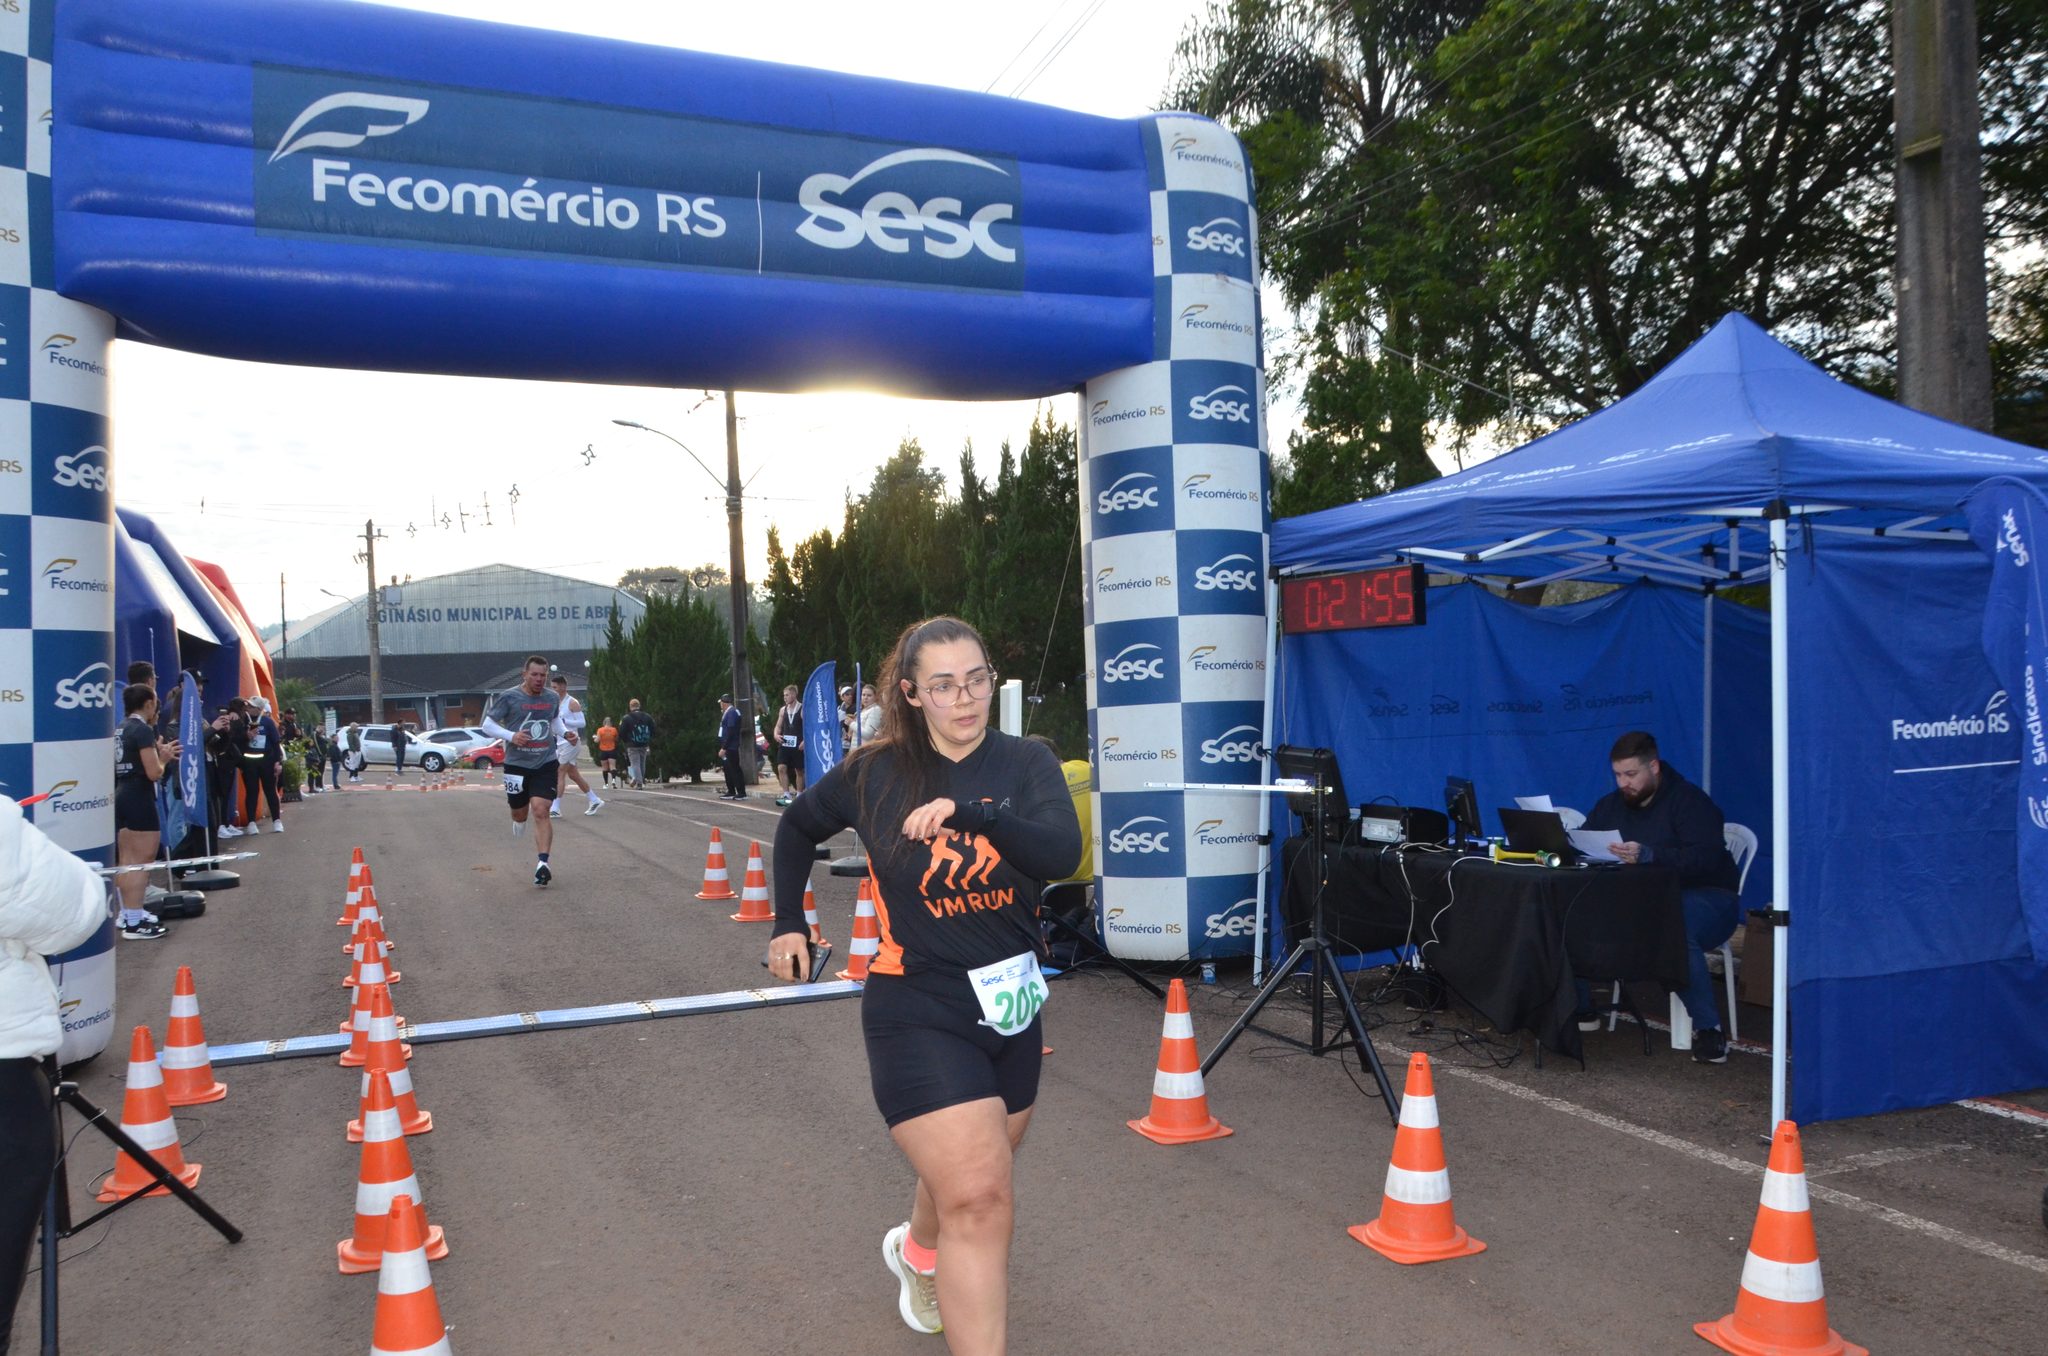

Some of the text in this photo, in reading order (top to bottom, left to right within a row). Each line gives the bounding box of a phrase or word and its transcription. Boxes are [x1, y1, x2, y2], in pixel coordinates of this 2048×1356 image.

[1177, 149, 1243, 174] Fecomércio RS
[312, 159, 727, 239] Fecomércio RS
[796, 148, 1017, 264] Sesc
[1186, 217, 1245, 258] Sesc
[1186, 317, 1254, 336] Fecomércio RS
[1093, 406, 1165, 427] Fecomércio RS
[1188, 385, 1250, 424] Sesc
[0, 460, 23, 473] RS
[1098, 472, 1158, 514] Sesc
[1189, 487, 1248, 501] Fecomércio
[1248, 491, 1259, 503] RS
[2001, 508, 2029, 568] Senac
[1098, 577, 1152, 594] Fecomércio
[1155, 575, 1171, 587] RS
[1194, 553, 1257, 592] Sesc
[376, 605, 627, 624] GINÁSIO MUNICIPAL 29 DE ABRL
[1103, 643, 1164, 683] Sesc
[1194, 659, 1265, 671] Fecomércio RS
[2, 689, 25, 702] RS
[54, 662, 113, 709] Sesc
[1892, 712, 2010, 740] Fecomércio RS
[2024, 665, 2048, 765] Sindicatos
[1104, 748, 1158, 762] Fecomércio
[1160, 748, 1177, 760] RS
[1200, 725, 1265, 764] Sesc
[179, 754, 199, 808] Sesc
[1108, 815, 1170, 853] Sesc
[1200, 832, 1260, 845] Fecomércio
[924, 887, 1015, 919] VM RUN
[1109, 920, 1162, 935] Fecomércio
[1165, 922, 1182, 935] RS
[980, 972, 1005, 987] Sesc
[61, 1007, 111, 1032] ecomércio
[994, 981, 1044, 1030] 206
